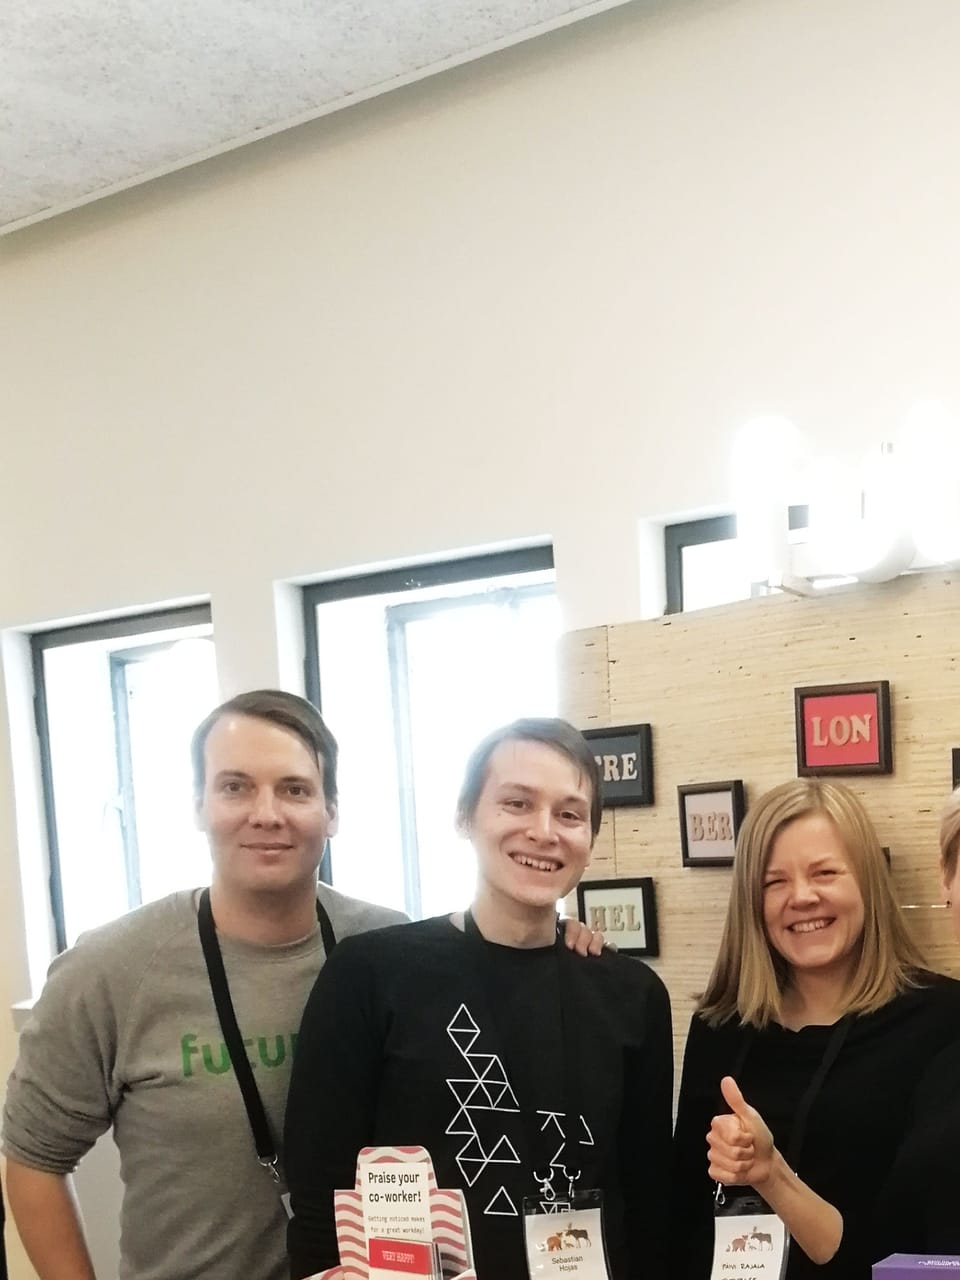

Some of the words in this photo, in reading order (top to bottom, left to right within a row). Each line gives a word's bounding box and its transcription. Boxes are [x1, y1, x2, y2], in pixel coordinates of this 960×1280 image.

[811, 713, 873, 747] LON
[594, 752, 638, 782] RE
[689, 812, 733, 842] BER
[589, 904, 641, 933] HEL
[368, 1172, 396, 1184] Praise
[398, 1173, 420, 1186] your
[368, 1191, 422, 1203] co-worker!
[551, 1255, 583, 1265] Sebastian
[559, 1264, 578, 1272] Hojas
